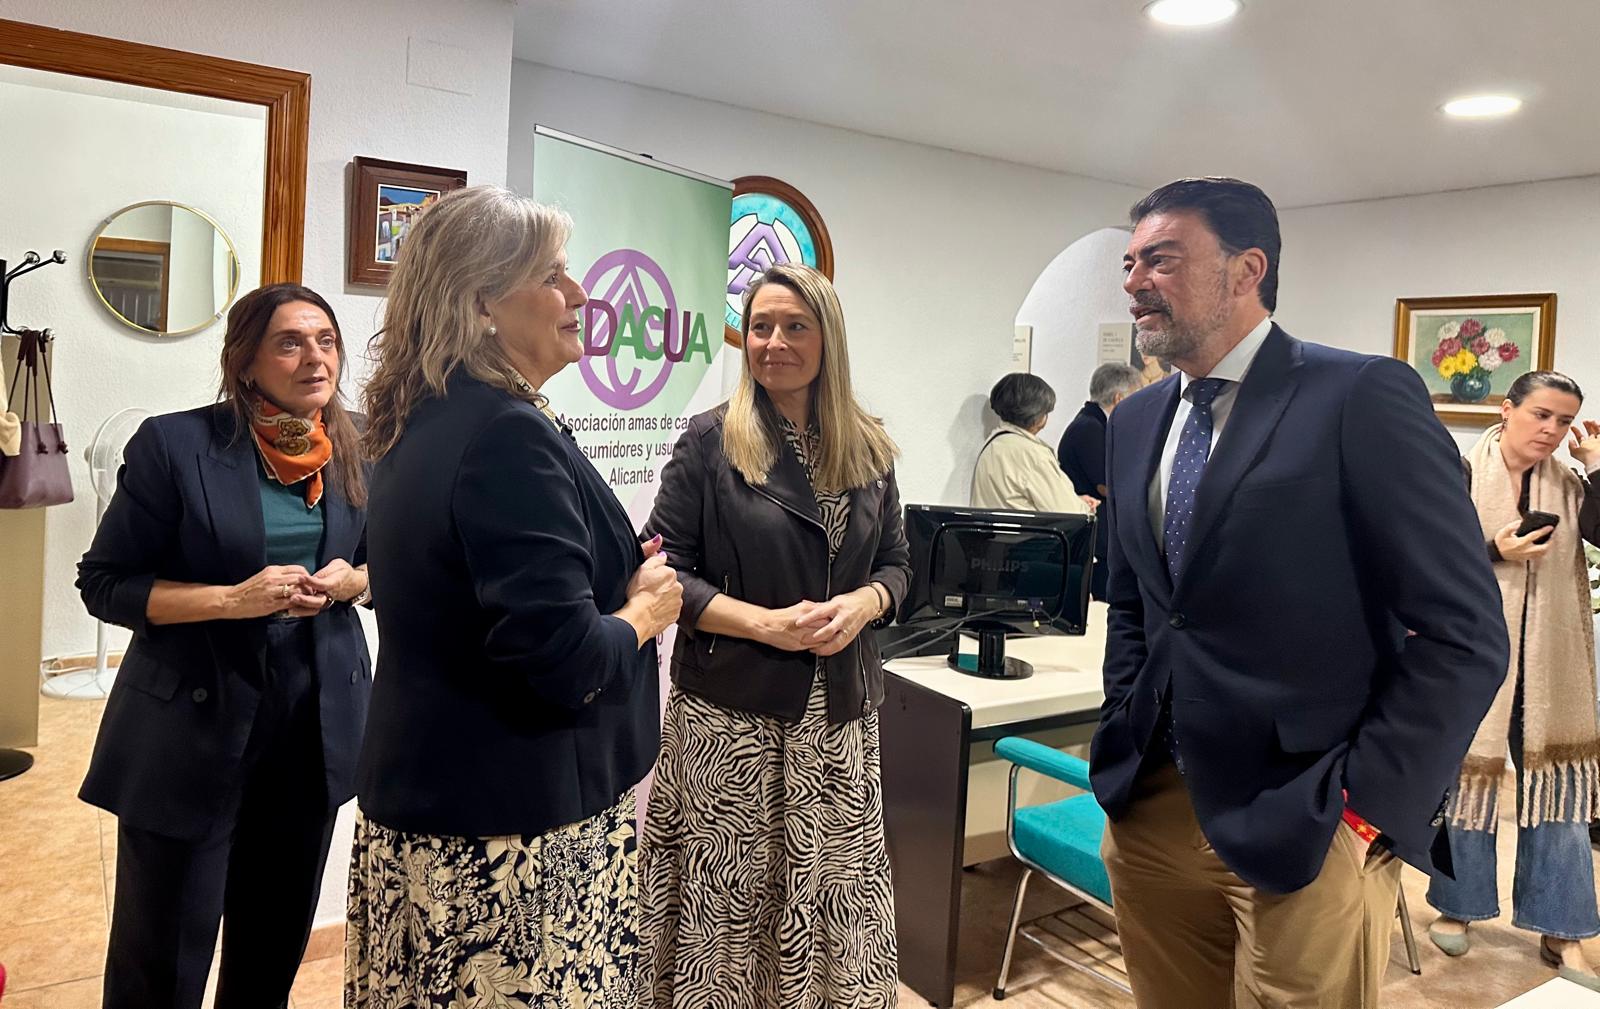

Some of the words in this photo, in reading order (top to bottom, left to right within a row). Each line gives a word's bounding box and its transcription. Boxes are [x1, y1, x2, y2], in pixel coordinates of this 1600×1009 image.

[577, 299, 712, 364] DACUA
[628, 416, 657, 431] amas
[660, 413, 672, 430] de
[675, 417, 688, 430] ca
[580, 440, 643, 460] sumidores
[646, 443, 652, 461] y
[655, 442, 673, 456] usu
[609, 466, 654, 486] Alicante
[971, 558, 1029, 572] PHILIPS
